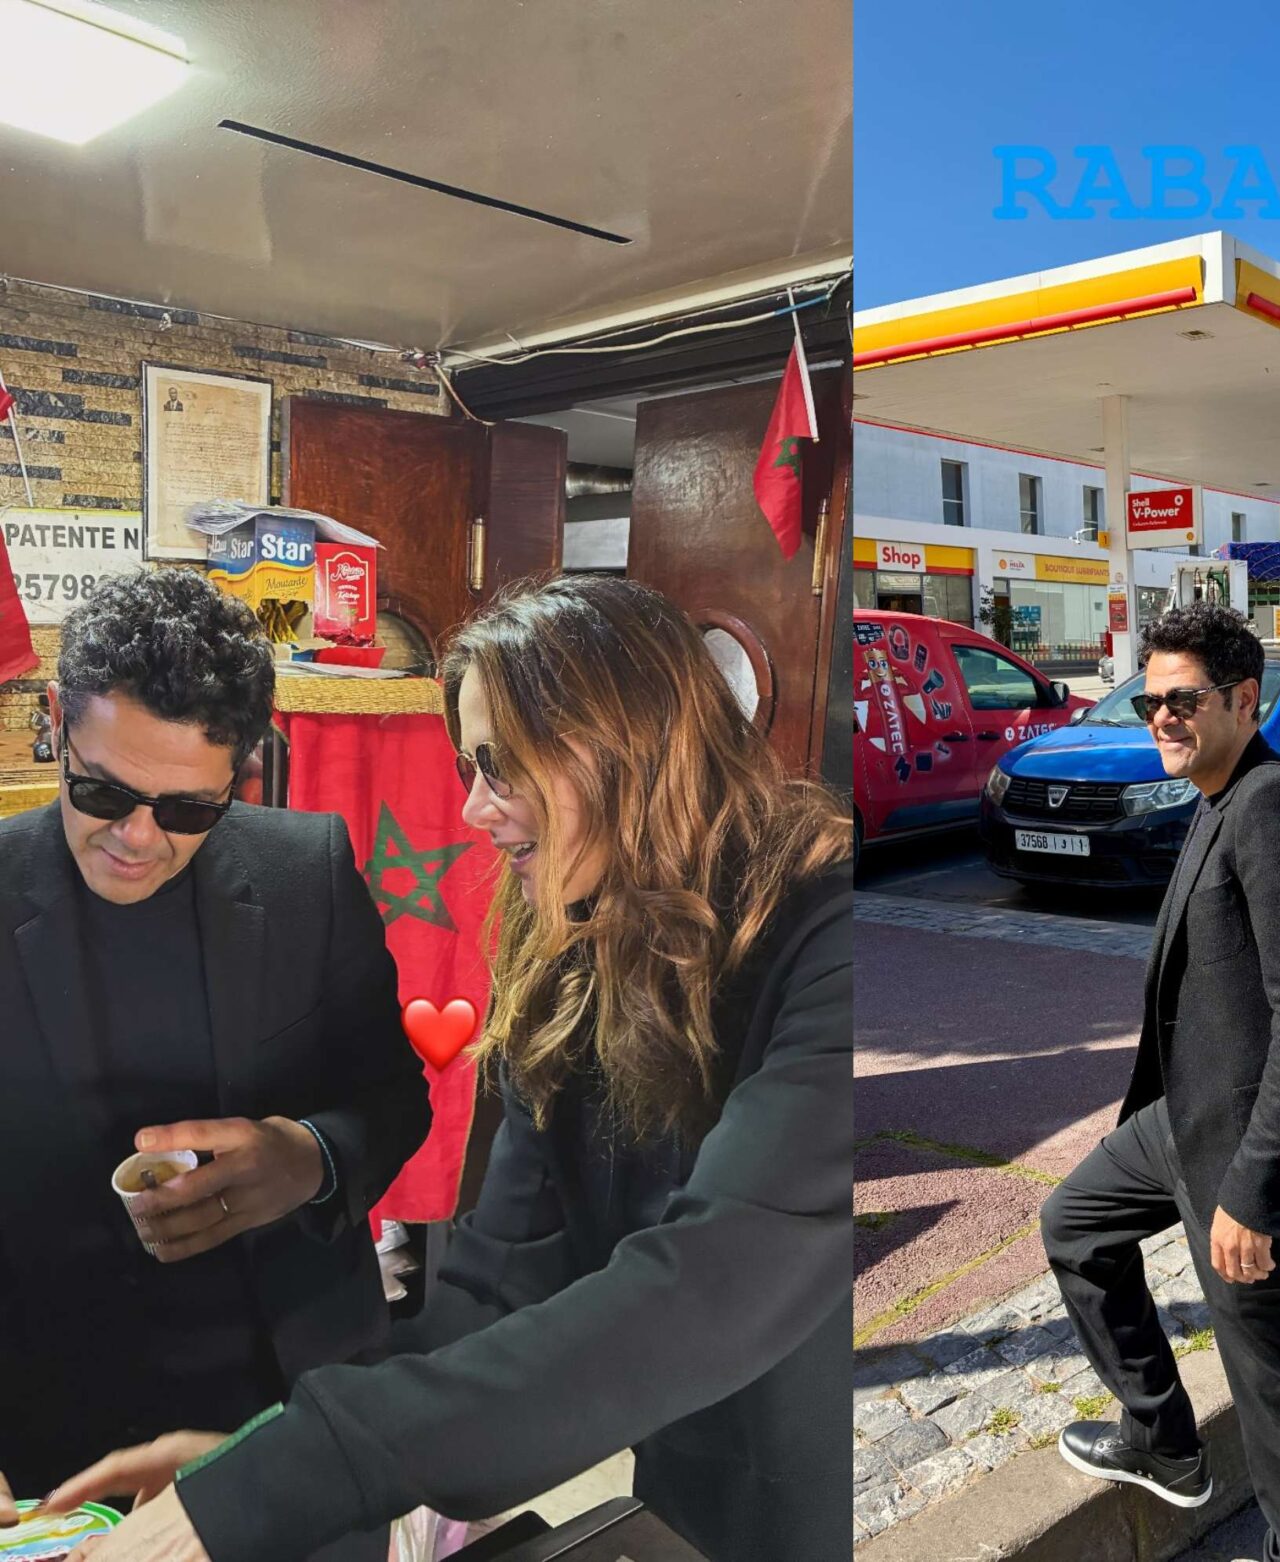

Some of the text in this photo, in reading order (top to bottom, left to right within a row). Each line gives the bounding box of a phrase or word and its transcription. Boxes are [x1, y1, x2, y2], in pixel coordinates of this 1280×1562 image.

[1132, 498, 1150, 508] Shell
[1132, 507, 1180, 519] V-Power
[5, 523, 139, 550] PATENTE N
[230, 537, 254, 560] Star
[261, 533, 312, 561] Star
[882, 546, 921, 570] Shop
[12, 573, 111, 600] 5798
[883, 700, 904, 755] ZATEC
[1020, 833, 1048, 850] 37568
